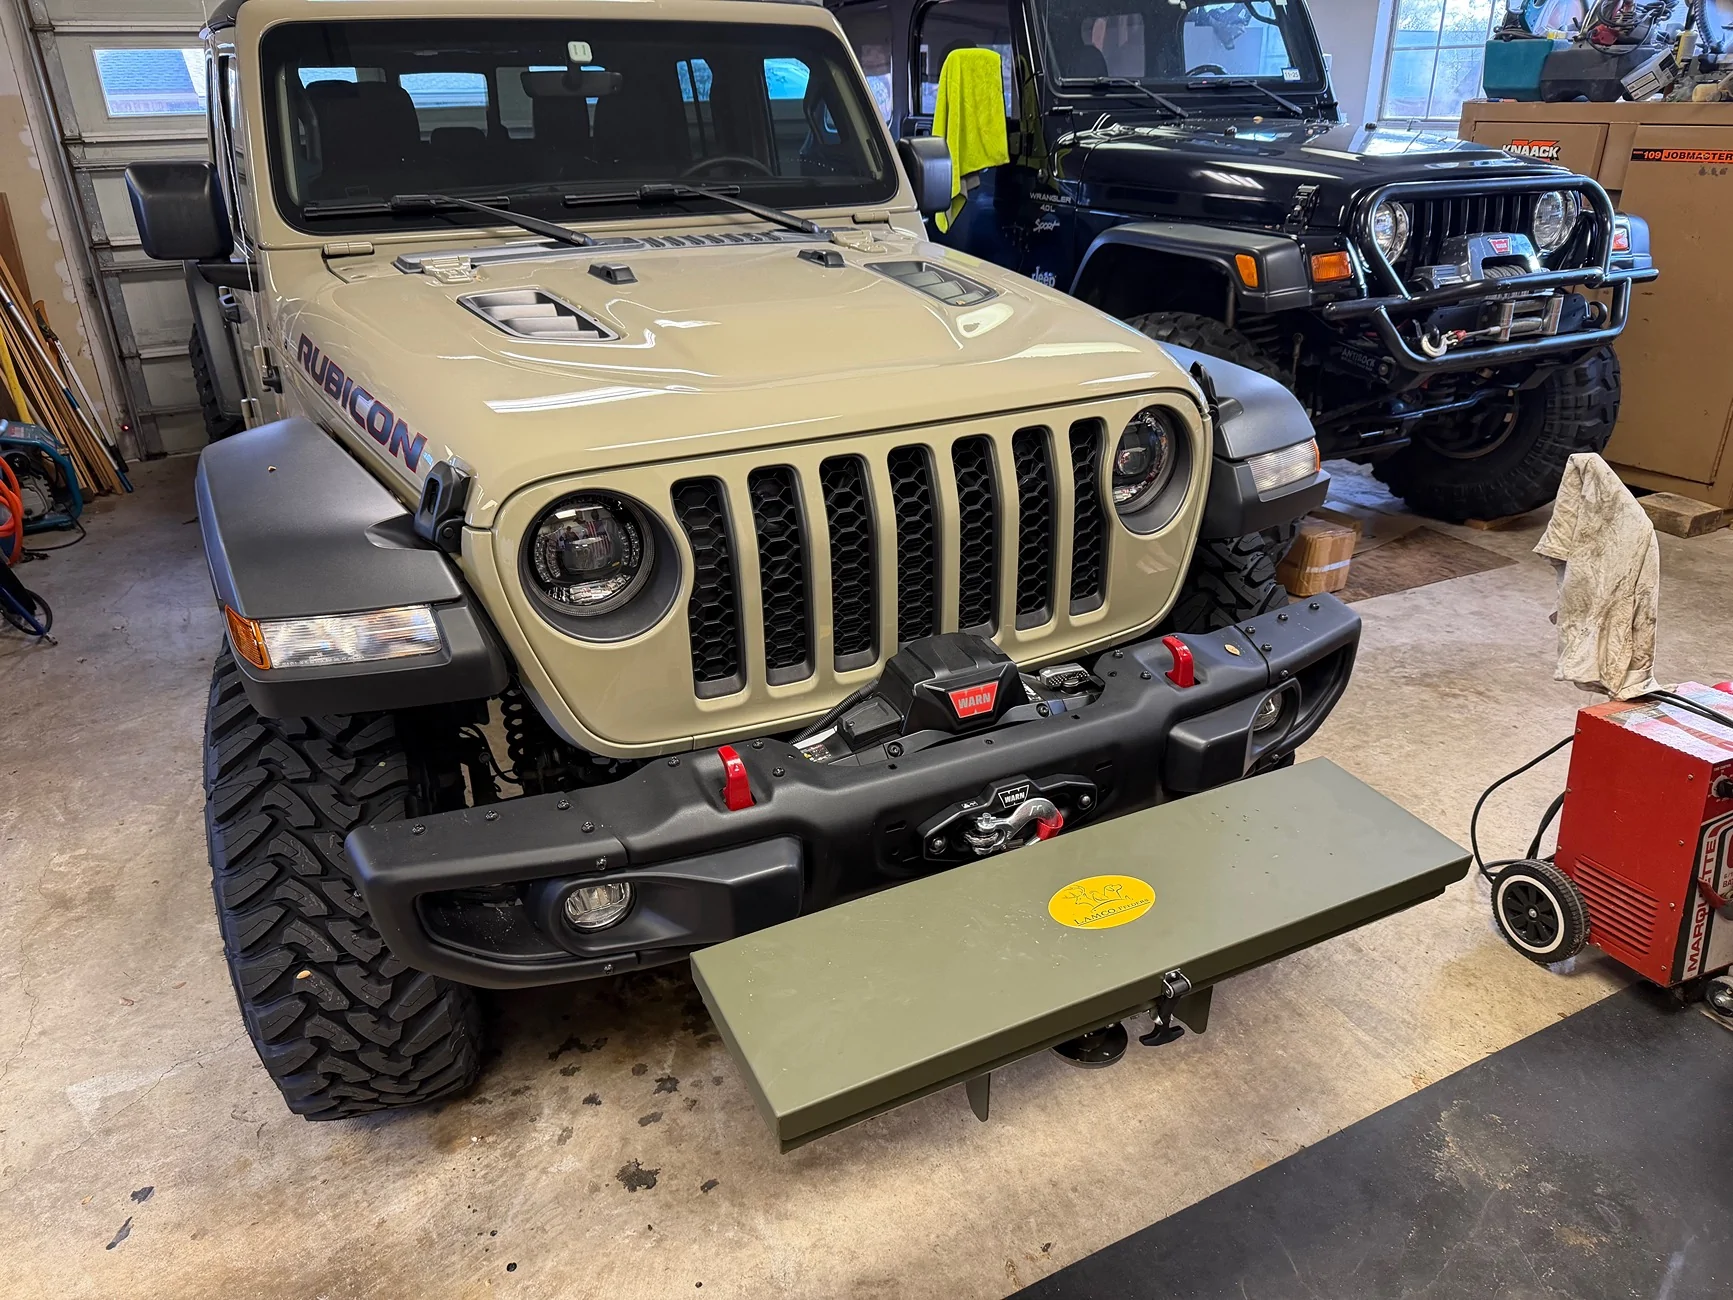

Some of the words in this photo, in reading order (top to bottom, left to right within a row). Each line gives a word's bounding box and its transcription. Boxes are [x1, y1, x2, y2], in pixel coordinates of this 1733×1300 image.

[1502, 144, 1560, 158] KNAACK
[1643, 151, 1662, 160] 109
[1664, 151, 1733, 161] JOBMASTER
[1029, 191, 1072, 204] WRANGLER
[297, 333, 428, 474] RUBICON
[957, 692, 992, 709] WARN
[1004, 791, 1025, 804] WARN
[1073, 907, 1117, 925] LAMCO
